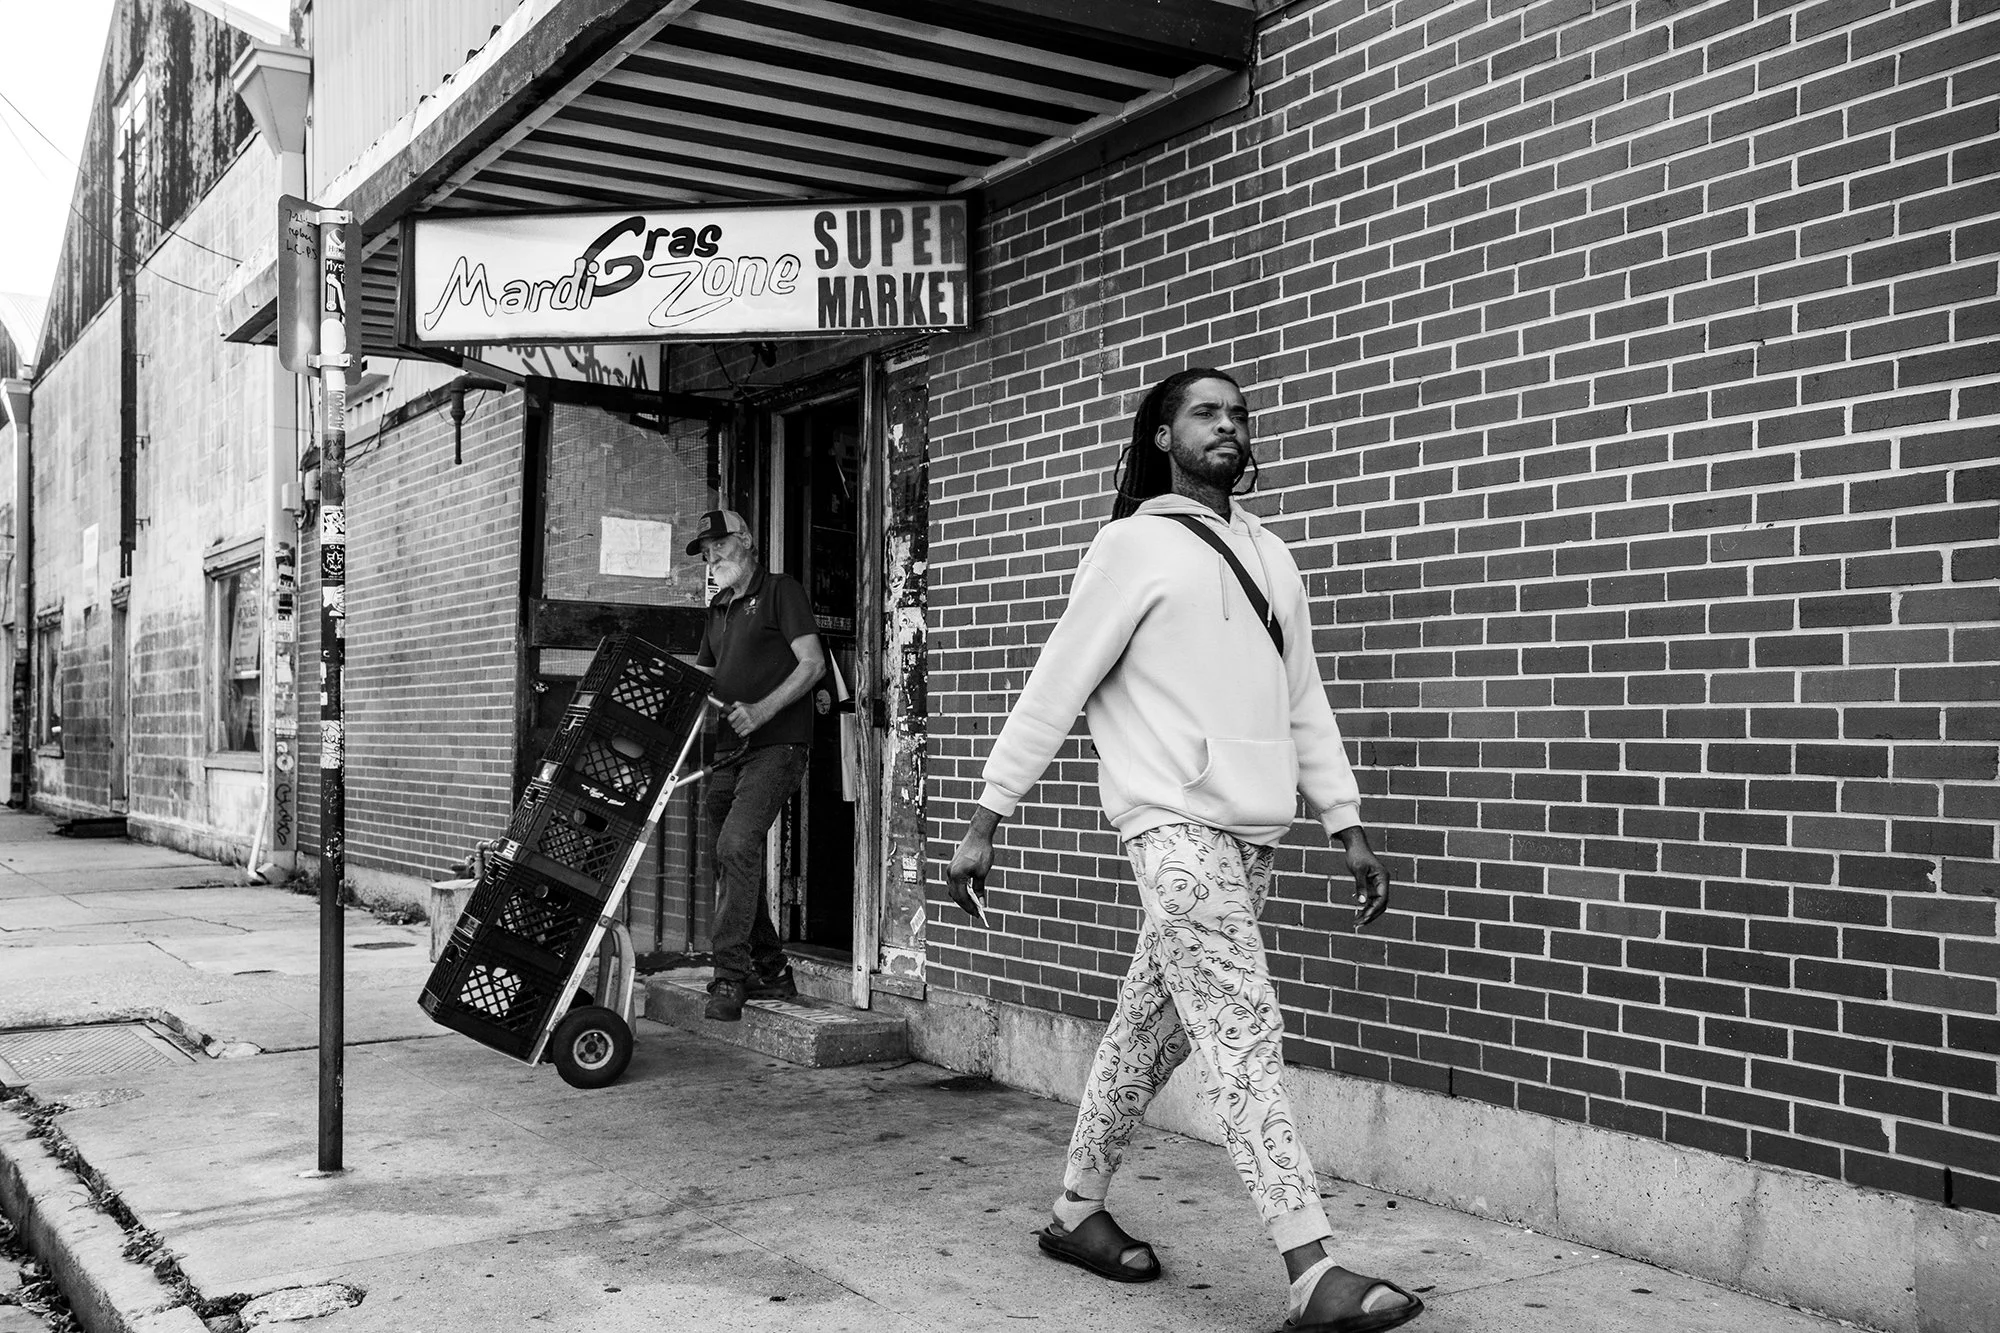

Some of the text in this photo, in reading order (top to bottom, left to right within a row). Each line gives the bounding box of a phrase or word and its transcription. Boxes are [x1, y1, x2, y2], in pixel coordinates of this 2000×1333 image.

[814, 205, 966, 270] SUPER
[424, 216, 723, 331] Mardi Gras
[648, 253, 802, 328] Zone
[817, 270, 967, 328] MARKET
